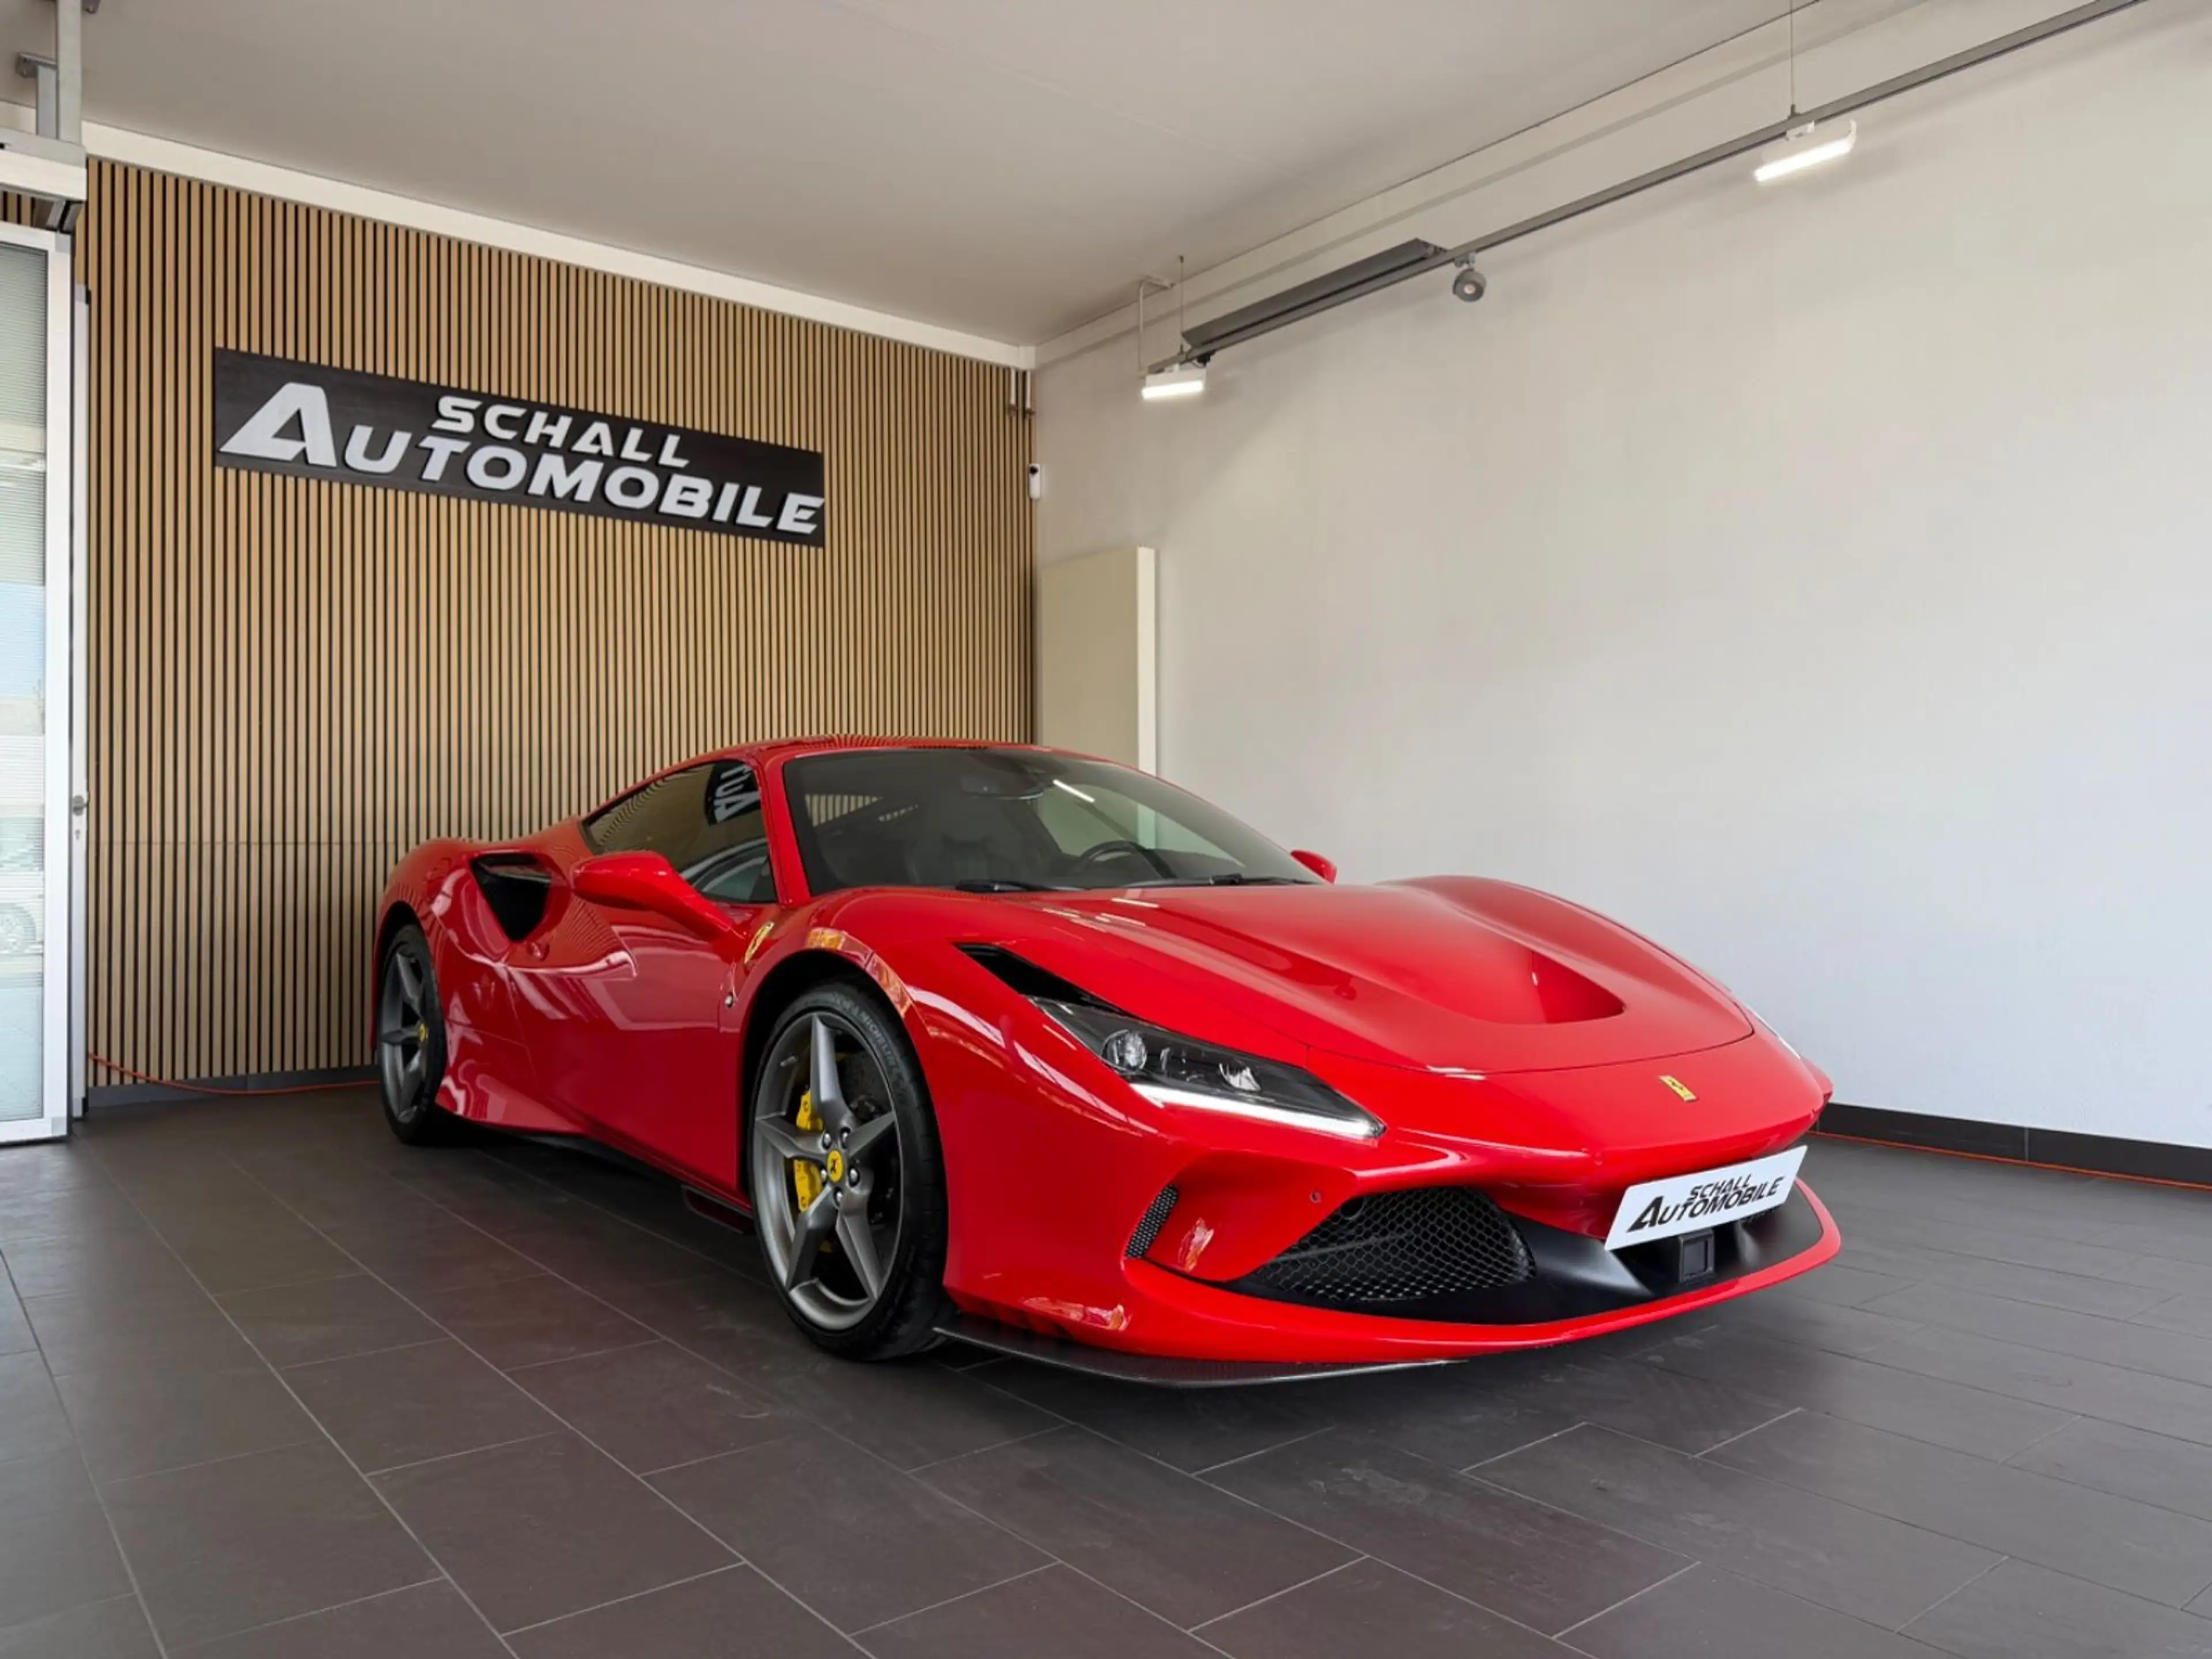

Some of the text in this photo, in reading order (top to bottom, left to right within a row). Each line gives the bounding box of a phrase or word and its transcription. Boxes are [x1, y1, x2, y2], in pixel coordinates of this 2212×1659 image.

[219, 382, 825, 535] AUTOMOBILE
[431, 396, 689, 468] SCHALL
[1626, 1176, 1785, 1233] AUTOMOBILE
[1687, 1173, 1752, 1201] SCHALL
